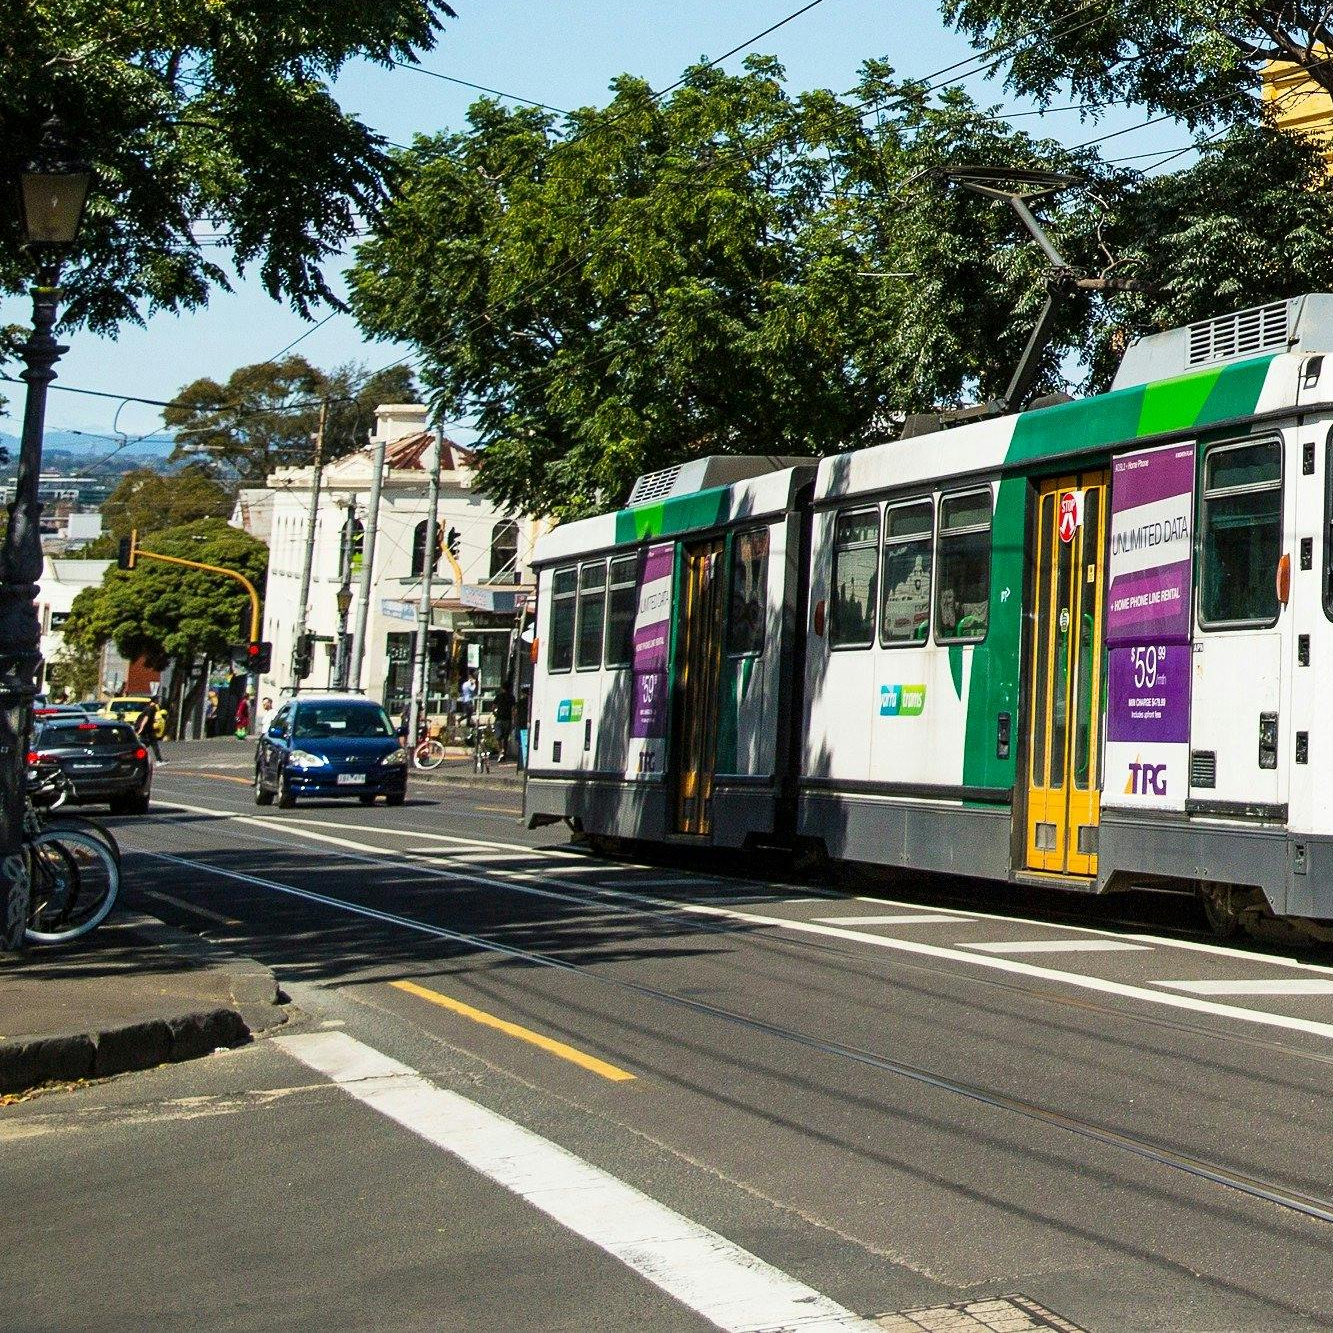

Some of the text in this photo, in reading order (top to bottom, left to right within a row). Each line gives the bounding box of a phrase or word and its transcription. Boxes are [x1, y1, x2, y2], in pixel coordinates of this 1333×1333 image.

[1061, 499, 1076, 514] STOP
[1112, 515, 1189, 556] UNLIMITED DATA
[1114, 597, 1130, 612] HOME
[1130, 593, 1148, 608] PHONE
[1148, 590, 1161, 605] LINE
[1160, 587, 1181, 602] RENTAL
[1129, 763, 1167, 796] TPG
